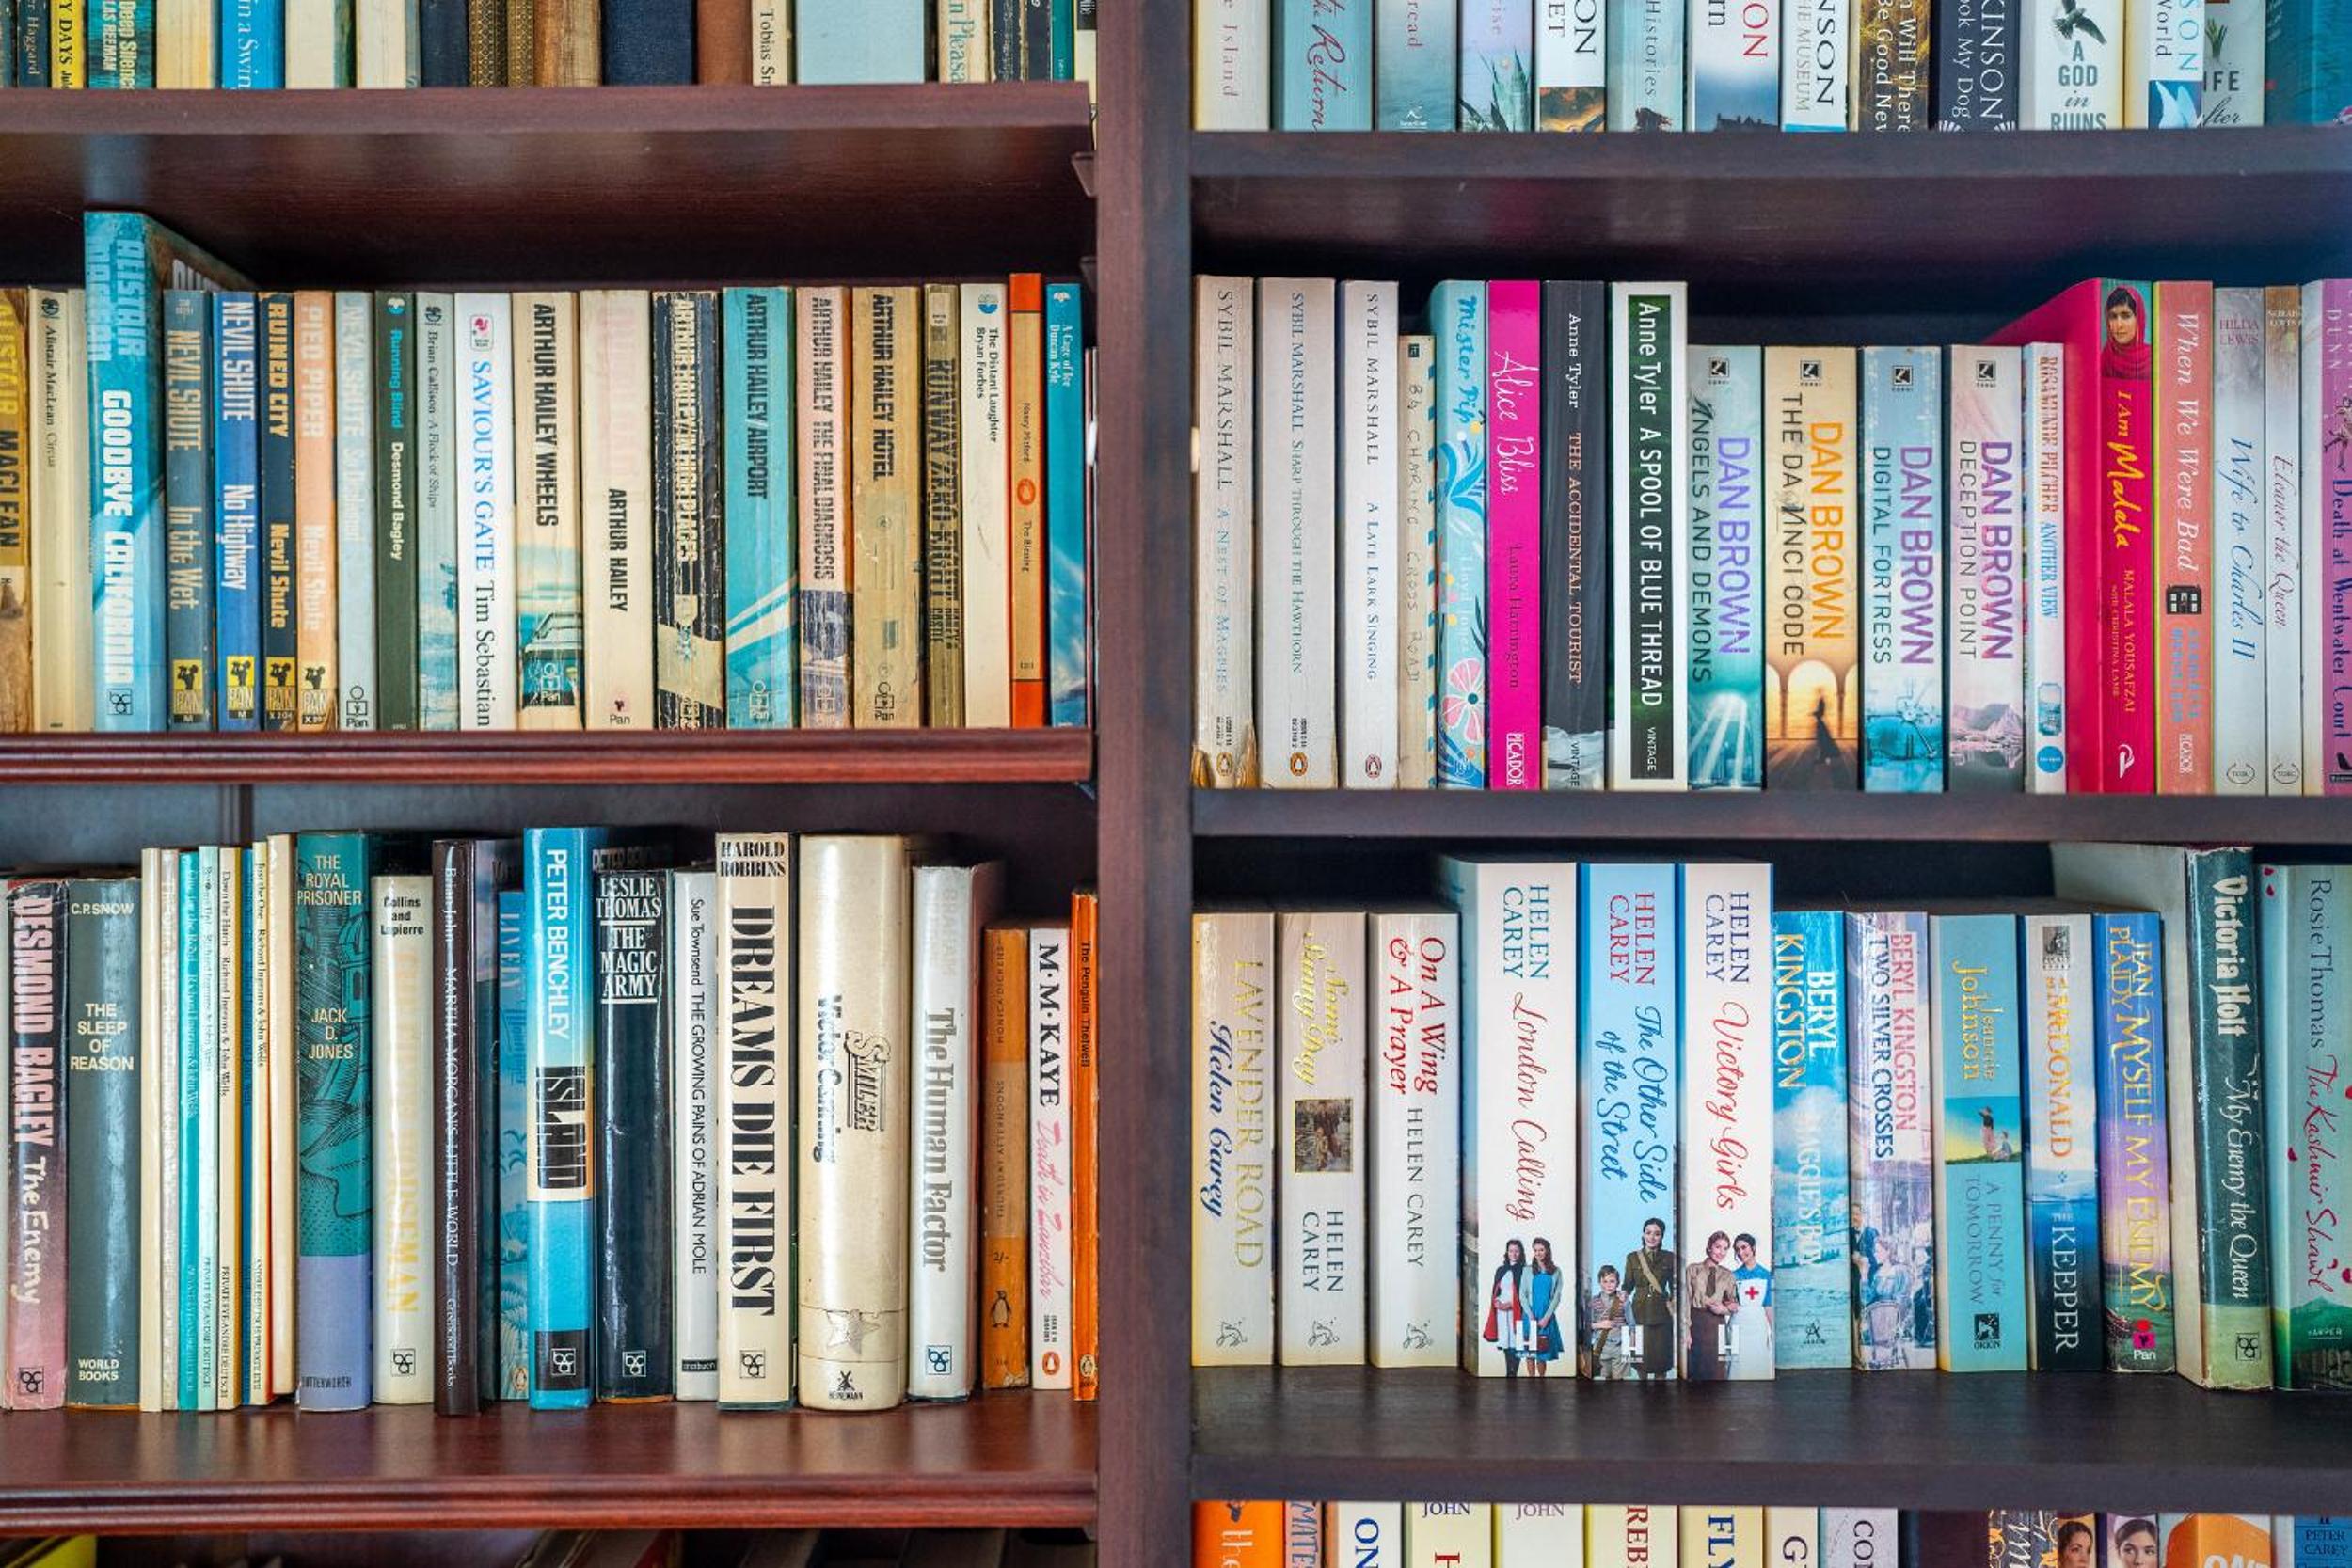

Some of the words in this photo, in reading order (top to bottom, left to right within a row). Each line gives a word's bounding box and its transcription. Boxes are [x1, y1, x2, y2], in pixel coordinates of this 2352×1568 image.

[758, 11, 772, 63] Tobias
[1222, 24, 1239, 98] Island
[1953, 38, 1975, 69] My
[2072, 40, 2084, 62] A
[1951, 77, 1974, 119] Dog
[2058, 65, 2099, 87] GOD
[168, 330, 201, 386] NEVIL
[223, 300, 254, 356] NEVIL
[533, 304, 557, 378] ARTHUR
[1568, 313, 1581, 356] Anne
[1640, 302, 1661, 356] Anne
[2176, 312, 2199, 384] When
[169, 388, 202, 451] SHUTE
[223, 359, 254, 421] SHUTE
[534, 382, 558, 445] HAILEY
[1491, 351, 1539, 421] Alice
[1565, 364, 1581, 408] Tyler
[1634, 363, 1661, 414] Tyler
[1782, 392, 1803, 443] THE
[2176, 399, 2199, 435] We
[102, 389, 133, 517] GOODBYE
[472, 360, 493, 494] SAVIOUR'S
[1568, 432, 1581, 470] THE
[1640, 428, 1661, 441] A
[1810, 422, 1843, 494] DAN
[223, 484, 255, 510] No
[536, 452, 559, 527] WHEELS
[1496, 436, 1534, 495] Bliss
[1640, 449, 1661, 518] SPOOL
[1718, 437, 1750, 509] DAN
[1782, 454, 1803, 489] DA
[1873, 446, 1891, 535] DIGITAL
[1899, 446, 1933, 518] DAN
[1981, 442, 2013, 515] DAN
[2176, 448, 2199, 509] Were
[169, 506, 202, 525] In
[474, 500, 494, 571] GATE
[608, 489, 628, 551] ARTHUR
[1568, 477, 1581, 595] ACCIDENTAL
[1640, 525, 1661, 551] OF
[1692, 508, 1711, 561] AND
[1959, 440, 1977, 577] DECEPTION
[170, 528, 202, 563] the
[215, 515, 254, 591] Highway
[1811, 505, 1844, 639] BROWN
[2176, 519, 2200, 572] Bad
[104, 531, 133, 683] CALIFORNIA
[170, 567, 203, 610] Wet
[475, 579, 495, 622] Tim
[609, 557, 628, 612] HAILEY
[1640, 560, 1662, 614] BLUE
[1718, 520, 1750, 654] BROWN
[1873, 546, 1892, 664] FORTRESS
[1900, 530, 1933, 664] BROWN
[1981, 526, 2013, 659] BROWN
[1568, 601, 1581, 683] TOURIST
[1692, 572, 1711, 683] DEMONS
[1783, 585, 1804, 656] CODE
[1960, 587, 1977, 658] POINT
[475, 630, 495, 727] Sebastian
[1641, 621, 1663, 706] THREAD
[1506, 733, 1524, 785] PICADOR
[298, 873, 351, 888] ROYAL
[315, 856, 340, 869] THE
[718, 860, 787, 878] ROBBINS
[720, 843, 786, 858] HAROLD
[297, 890, 363, 906] PRISONER
[545, 848, 568, 921] PETER
[595, 897, 662, 918] THOMAS
[600, 876, 655, 897] LESLIE
[691, 898, 705, 922] Sue
[2308, 879, 2332, 944] Rosie
[608, 926, 647, 948] THE
[691, 924, 705, 986] Townsend
[1419, 937, 1445, 980] On
[1503, 887, 1523, 979] CAREY
[1529, 884, 1549, 980] HELEN
[1609, 895, 1629, 985] CAREY
[1634, 892, 1655, 986] HELEN
[1704, 894, 1724, 983] CAREY
[1730, 892, 1750, 983] HELEN
[2212, 875, 2248, 979] Victoria
[13, 895, 54, 1036] DESMOND
[547, 926, 570, 1039] BENCHLEY
[600, 952, 658, 974] MAGIC
[601, 975, 656, 998] ARMY
[1389, 976, 1412, 996] A
[1869, 935, 1889, 987] TWO
[1890, 933, 1913, 999] BERYL
[2109, 927, 2134, 1011] PLAIDY
[2131, 941, 2153, 998] JEAN
[77, 1021, 127, 1035] SLEEP
[86, 1004, 118, 1017] THE
[311, 1008, 348, 1022] JACK
[691, 992, 706, 1021] THE
[730, 905, 776, 1088] DREAMS
[1420, 990, 1446, 1012] A
[1635, 1006, 1664, 1051] The
[1775, 933, 1805, 1088] KINGSTON
[1806, 970, 1836, 1059] BERYL
[1871, 993, 1891, 1062] SILVER
[1951, 961, 1989, 1081] Johnson
[2208, 983, 2252, 1037] Holt
[2307, 944, 2333, 1049] Thomas
[71, 1056, 135, 1070] REASON
[89, 1039, 112, 1053] OF
[308, 1043, 354, 1059] JONES
[325, 1026, 339, 1041] D.
[691, 1024, 707, 1102] GROWING
[923, 1007, 956, 1062] The
[1208, 1020, 1232, 1113] Helen
[1234, 959, 1263, 1146] LAVENDER
[1383, 1007, 1413, 1095] Prayer
[1413, 1023, 1446, 1095] Wing
[1512, 992, 1547, 1108] London
[1595, 1031, 1626, 1054] of
[1706, 1001, 1750, 1128] Victory
[13, 1046, 54, 1147] BAGLEY
[1602, 1060, 1626, 1094] the
[1634, 1057, 1668, 1138] Other
[1893, 1008, 1917, 1131] KINGSTON
[2220, 1076, 2251, 1125] My
[691, 1105, 707, 1146] PAINS
[731, 1101, 776, 1176] DIE
[922, 1065, 955, 1179] Human
[1406, 1108, 1423, 1182] HELEN
[1596, 1096, 1631, 1180] Street
[1874, 1069, 1894, 1159] CROSSES
[17, 1156, 46, 1206] The
[691, 1148, 707, 1168] OF
[1200, 1128, 1232, 1218] Carey
[1506, 1119, 1547, 1222] Calling
[1637, 1139, 1668, 1202] Side
[1709, 1126, 1747, 1211] Girls
[2221, 1128, 2253, 1196] Enemy
[691, 1170, 707, 1228] ADRIAN
[922, 1181, 953, 1273] Factor
[1235, 1164, 1263, 1268] ROAD
[1406, 1194, 1424, 1268] CAREY
[2231, 1201, 2259, 1230] the
[10, 1210, 48, 1304] Enemy
[692, 1233, 707, 1275] MOLE
[732, 1190, 777, 1317] FIRST
[1302, 1212, 1319, 1292] CAREY
[1327, 1210, 1343, 1292] HELEN
[1963, 1175, 1984, 1305] TOMORROW
[2229, 1234, 2258, 1299] Queen
[2052, 1226, 2079, 1354] KEEPER
